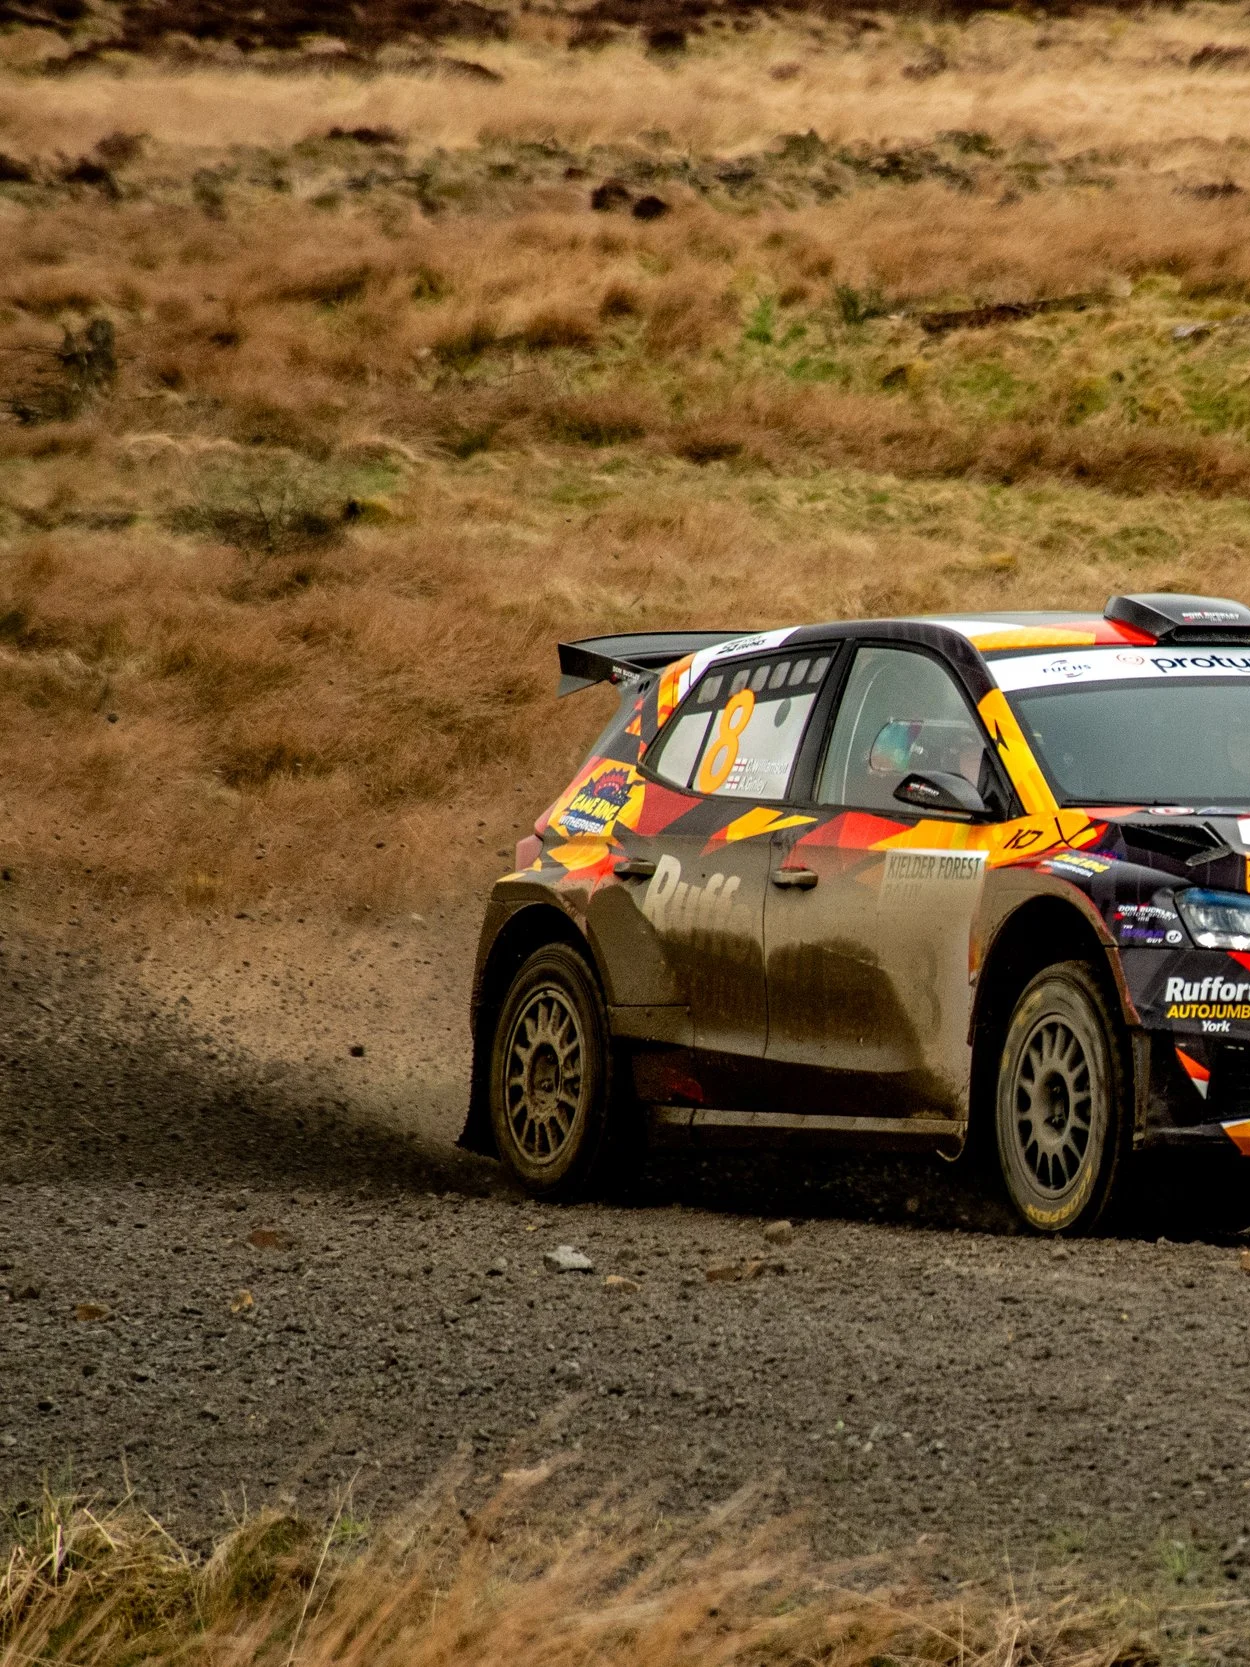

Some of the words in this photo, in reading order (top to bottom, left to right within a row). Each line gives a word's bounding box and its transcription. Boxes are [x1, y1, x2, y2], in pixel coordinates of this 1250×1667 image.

[1042, 663, 1092, 674] FUCHS
[699, 688, 755, 794] 8
[887, 856, 936, 879] KIELDER
[937, 856, 982, 880] FOREST
[1201, 1020, 1231, 1033] York
